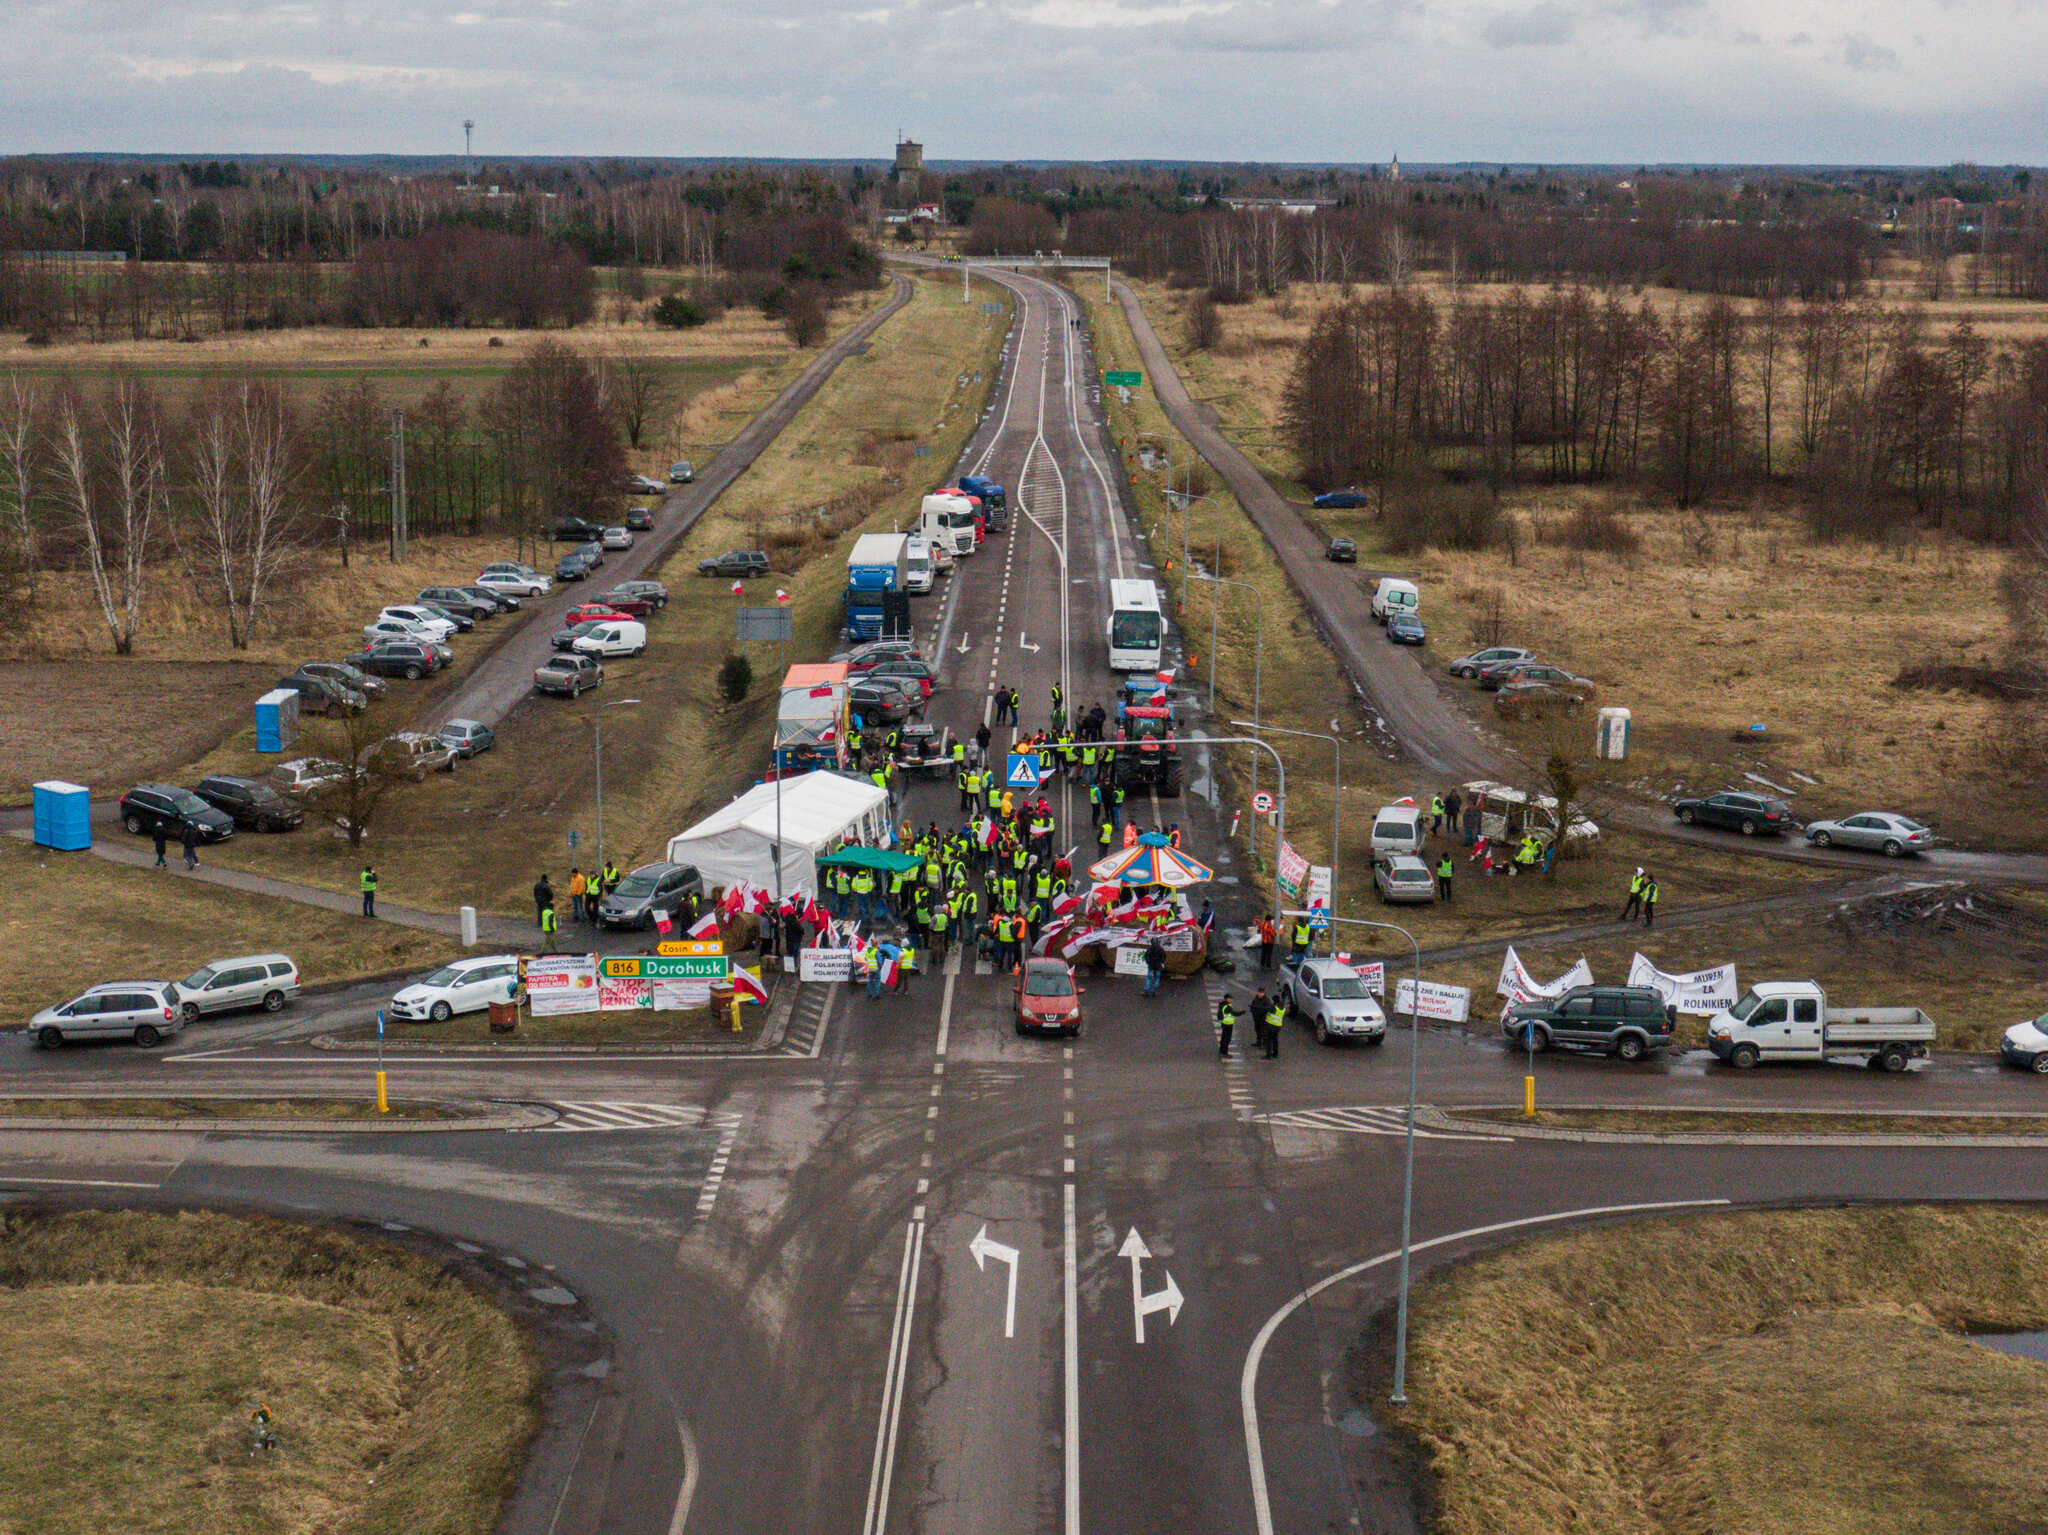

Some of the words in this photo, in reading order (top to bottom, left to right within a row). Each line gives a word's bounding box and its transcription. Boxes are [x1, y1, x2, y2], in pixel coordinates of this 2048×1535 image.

[662, 944, 688, 953] Zosin
[612, 962, 634, 974] 816
[646, 961, 721, 975] Dorohusk
[612, 978, 646, 988] STOP
[1702, 985, 1715, 994] ZA
[1439, 991, 1465, 1000] BALUJE
[637, 996, 653, 1007] UA
[1422, 997, 1447, 1006] ROLNIK
[1682, 998, 1733, 1009] ROLNIKIEM
